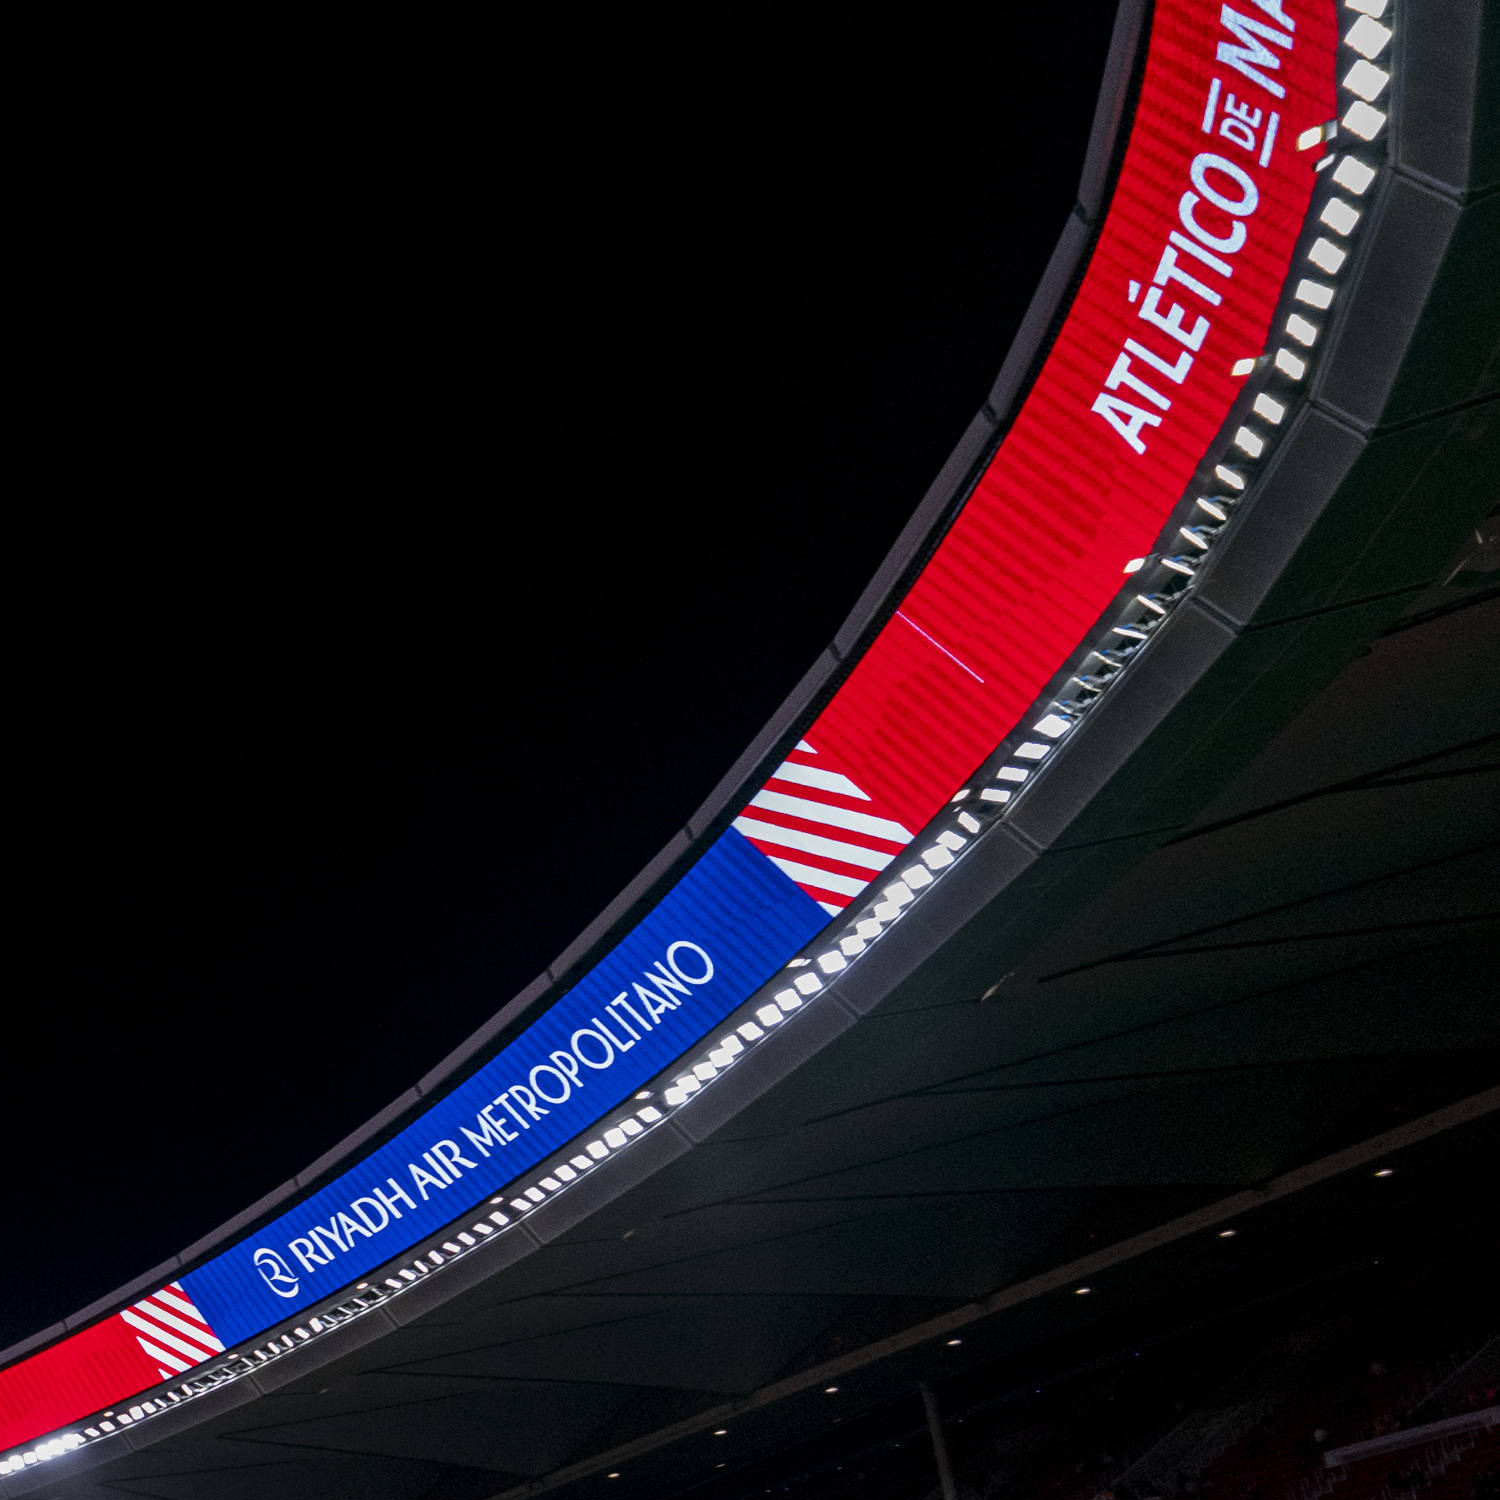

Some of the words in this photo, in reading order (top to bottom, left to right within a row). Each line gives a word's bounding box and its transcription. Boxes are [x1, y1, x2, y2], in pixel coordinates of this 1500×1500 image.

[1090, 151, 1260, 456] ATLÉTICO
[1218, 93, 1263, 152] DE
[287, 1176, 418, 1274] RIYADH
[407, 1138, 478, 1202] AIR
[459, 940, 714, 1158] METROPOLITANO
